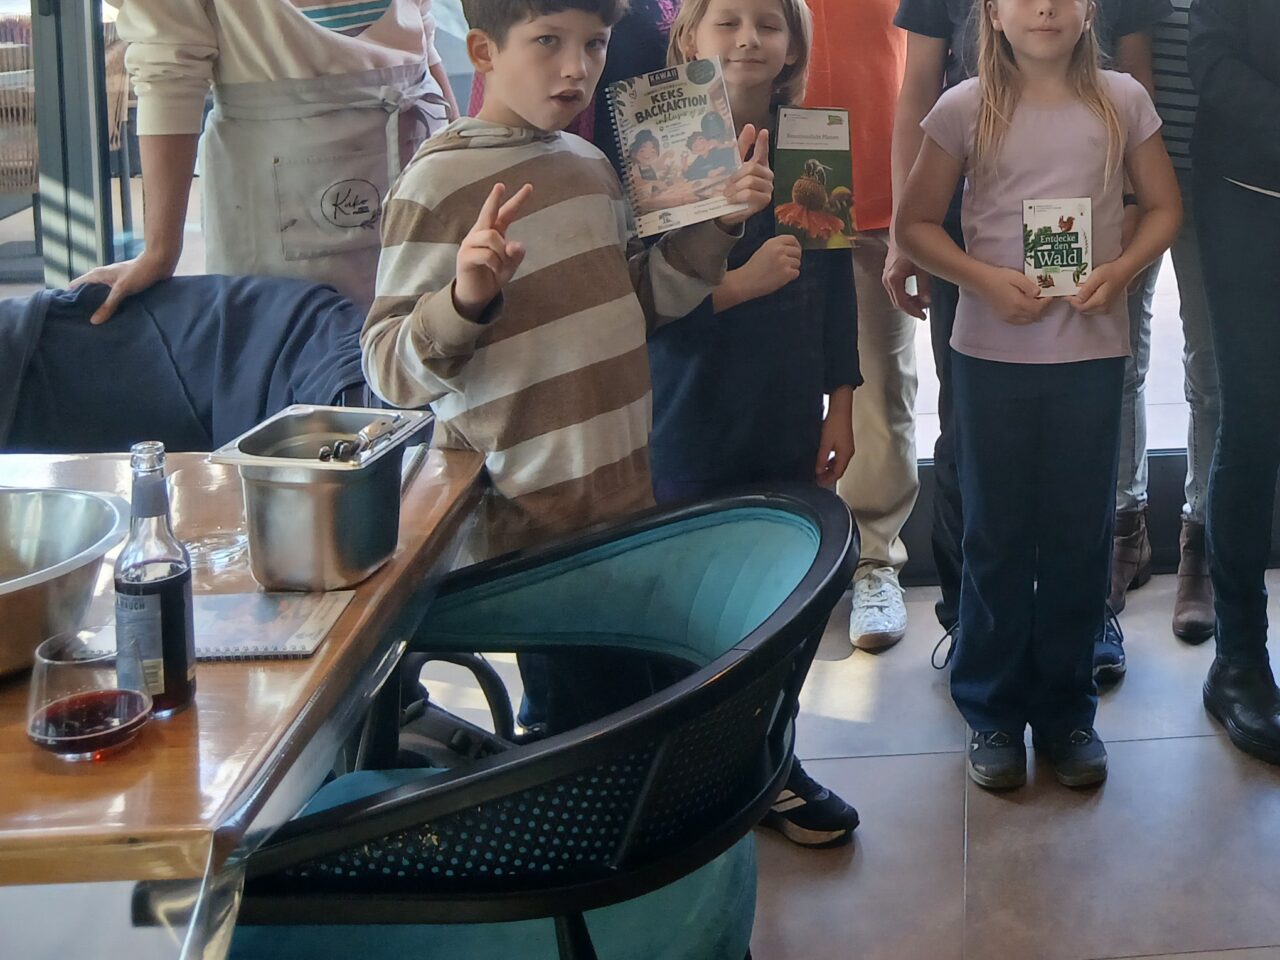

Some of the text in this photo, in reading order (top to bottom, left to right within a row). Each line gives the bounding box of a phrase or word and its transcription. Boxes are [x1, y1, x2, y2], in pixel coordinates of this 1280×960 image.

[650, 87, 684, 105] KEKS
[635, 95, 707, 124] BACKAKTION
[1040, 234, 1076, 244] Entdecke
[1054, 242, 1069, 250] den
[1037, 249, 1078, 265] Wald
